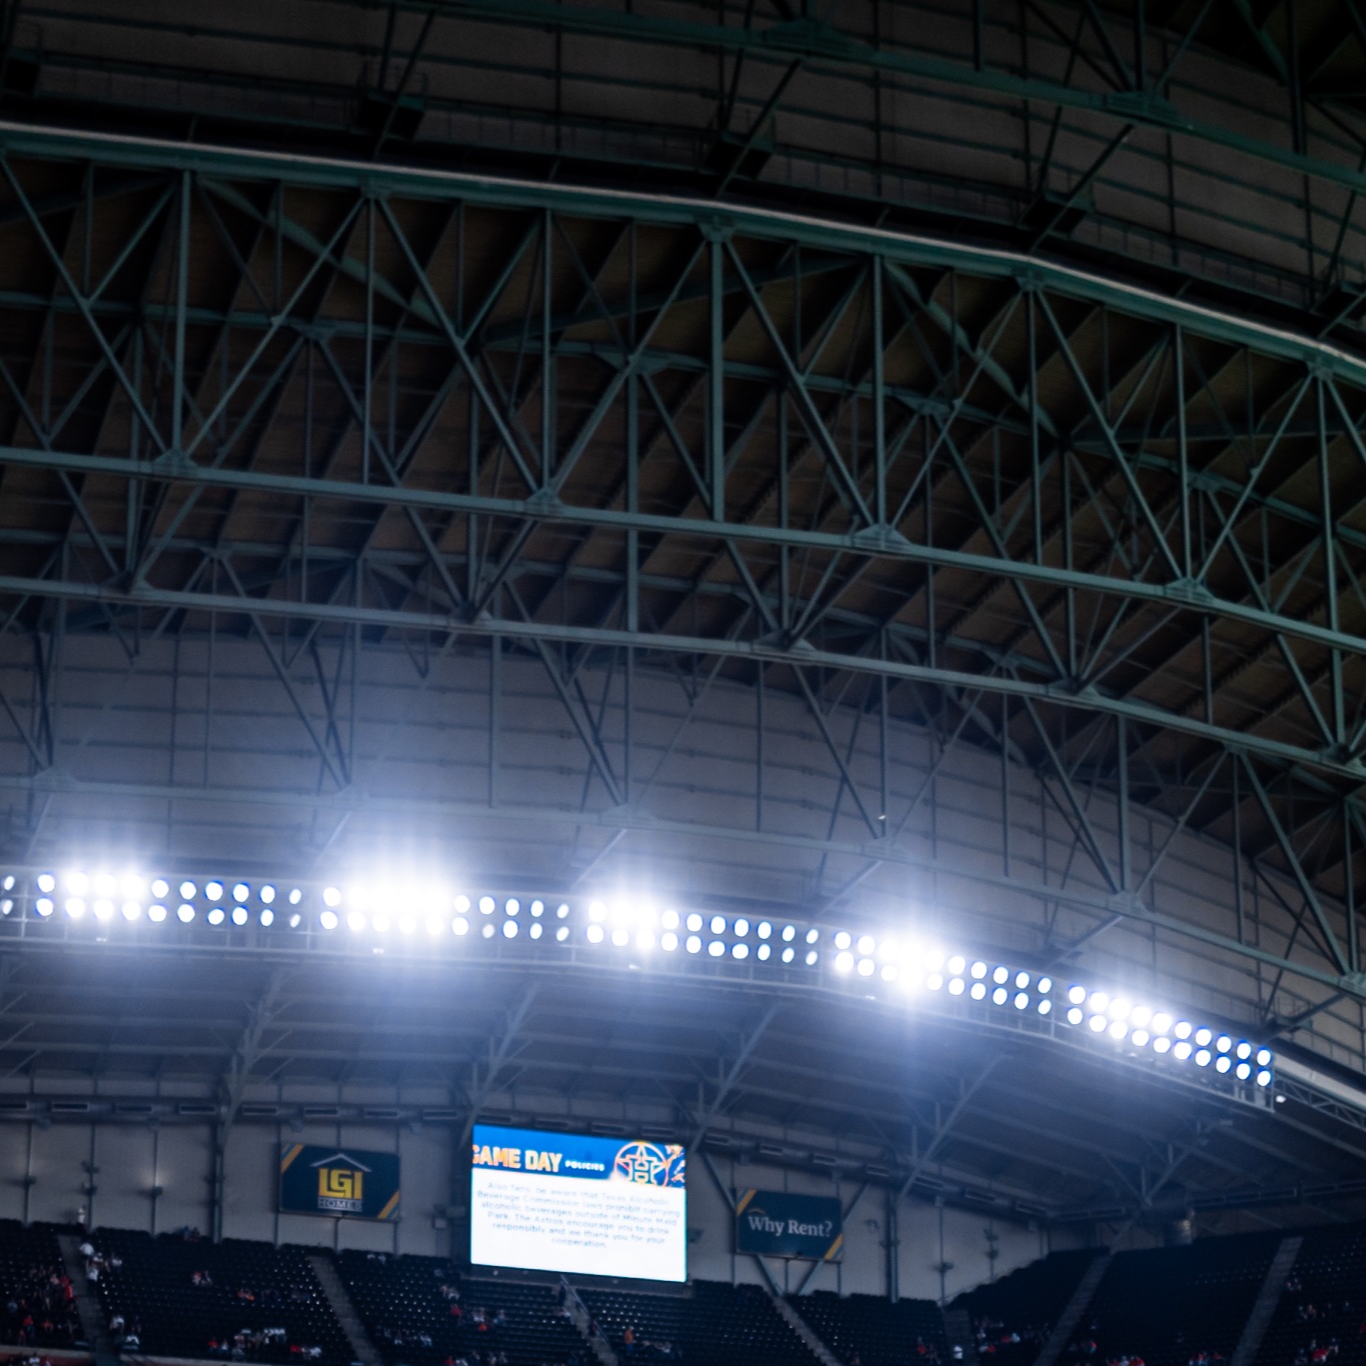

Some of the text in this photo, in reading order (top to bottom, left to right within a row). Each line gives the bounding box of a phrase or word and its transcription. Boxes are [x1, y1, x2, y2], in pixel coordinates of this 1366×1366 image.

[525, 1150, 563, 1173] DAY
[319, 1168, 363, 1199] LGI
[317, 1199, 363, 1210] HOMES
[748, 1216, 833, 1237] Why Rent?
